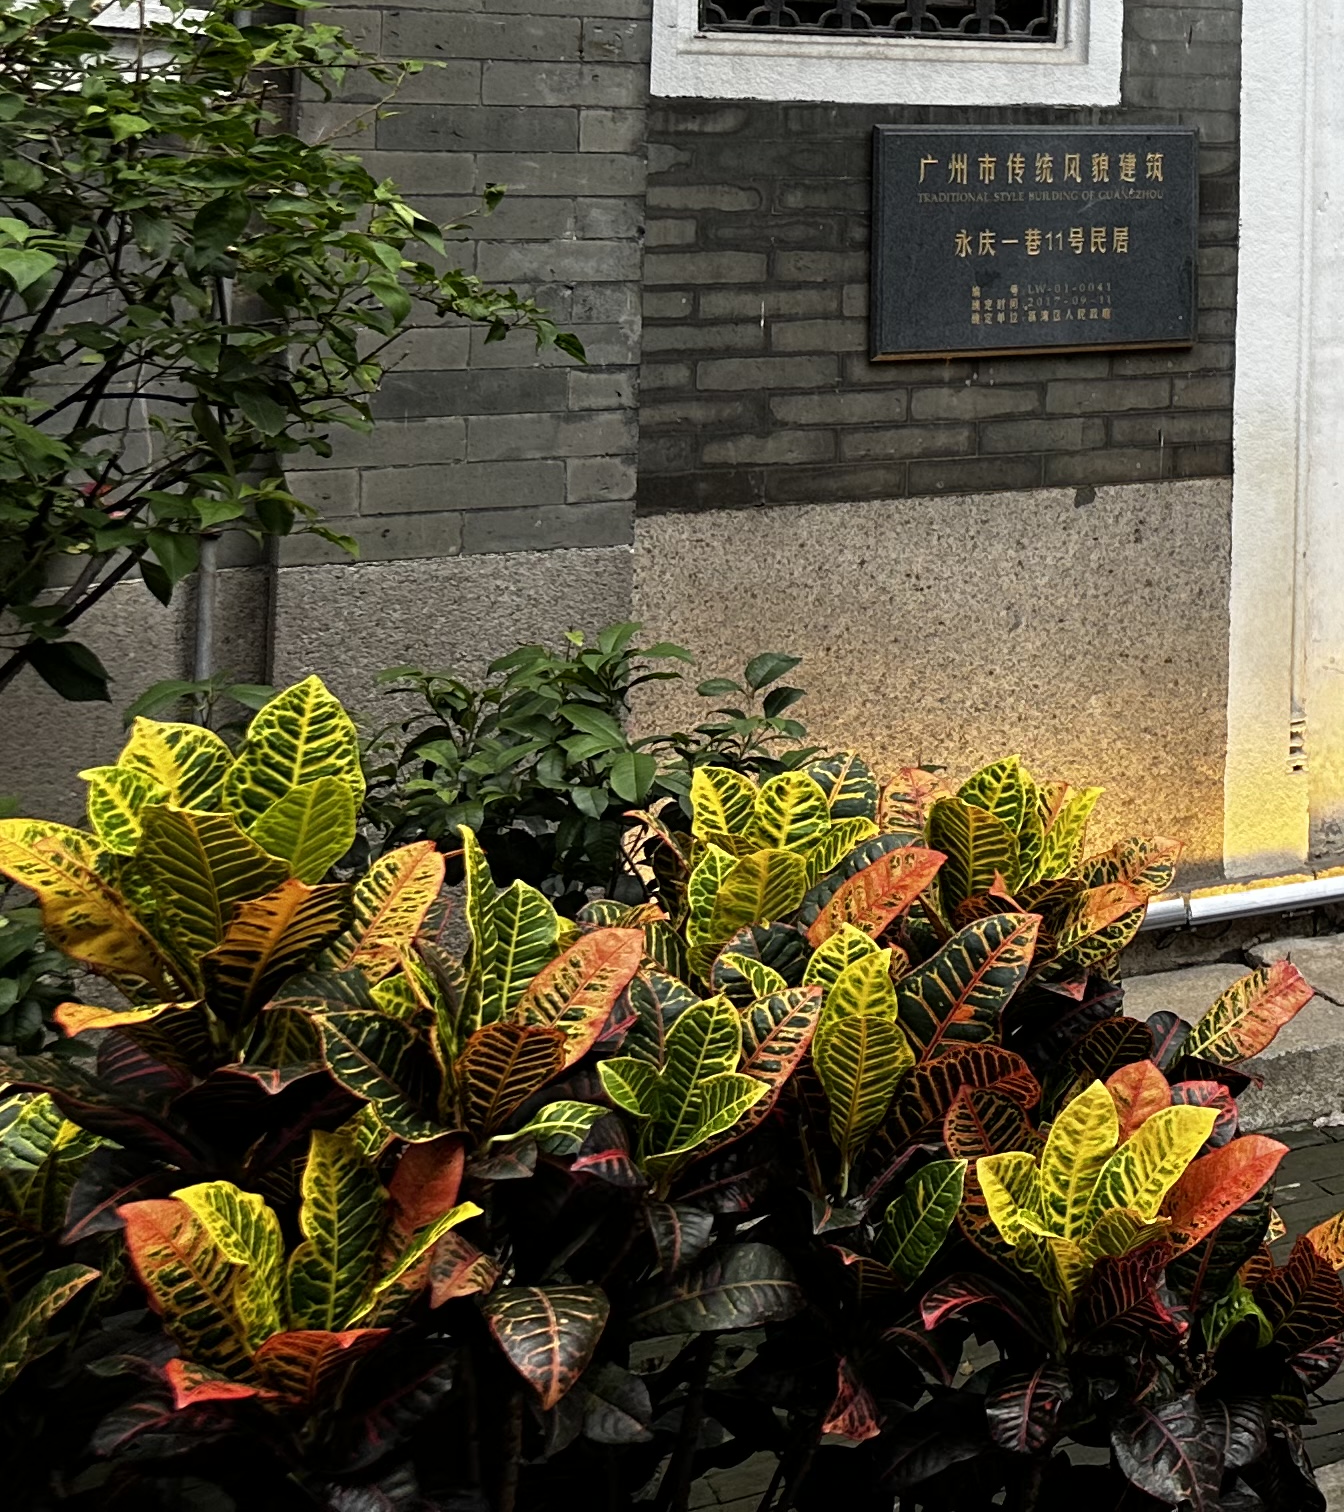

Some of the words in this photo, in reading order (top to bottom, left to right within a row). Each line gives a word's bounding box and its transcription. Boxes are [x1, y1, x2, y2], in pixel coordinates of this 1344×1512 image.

[918, 152, 1165, 185] 广州市传统风貌建筑
[917, 191, 989, 203] TRADITIONAL
[993, 191, 1024, 202] STYLE
[1028, 190, 1079, 201] BUILDING
[1081, 190, 1097, 201] OF
[1098, 188, 1164, 201] GUANGZHOU
[953, 227, 1130, 258] 永庆一巷11号民居
